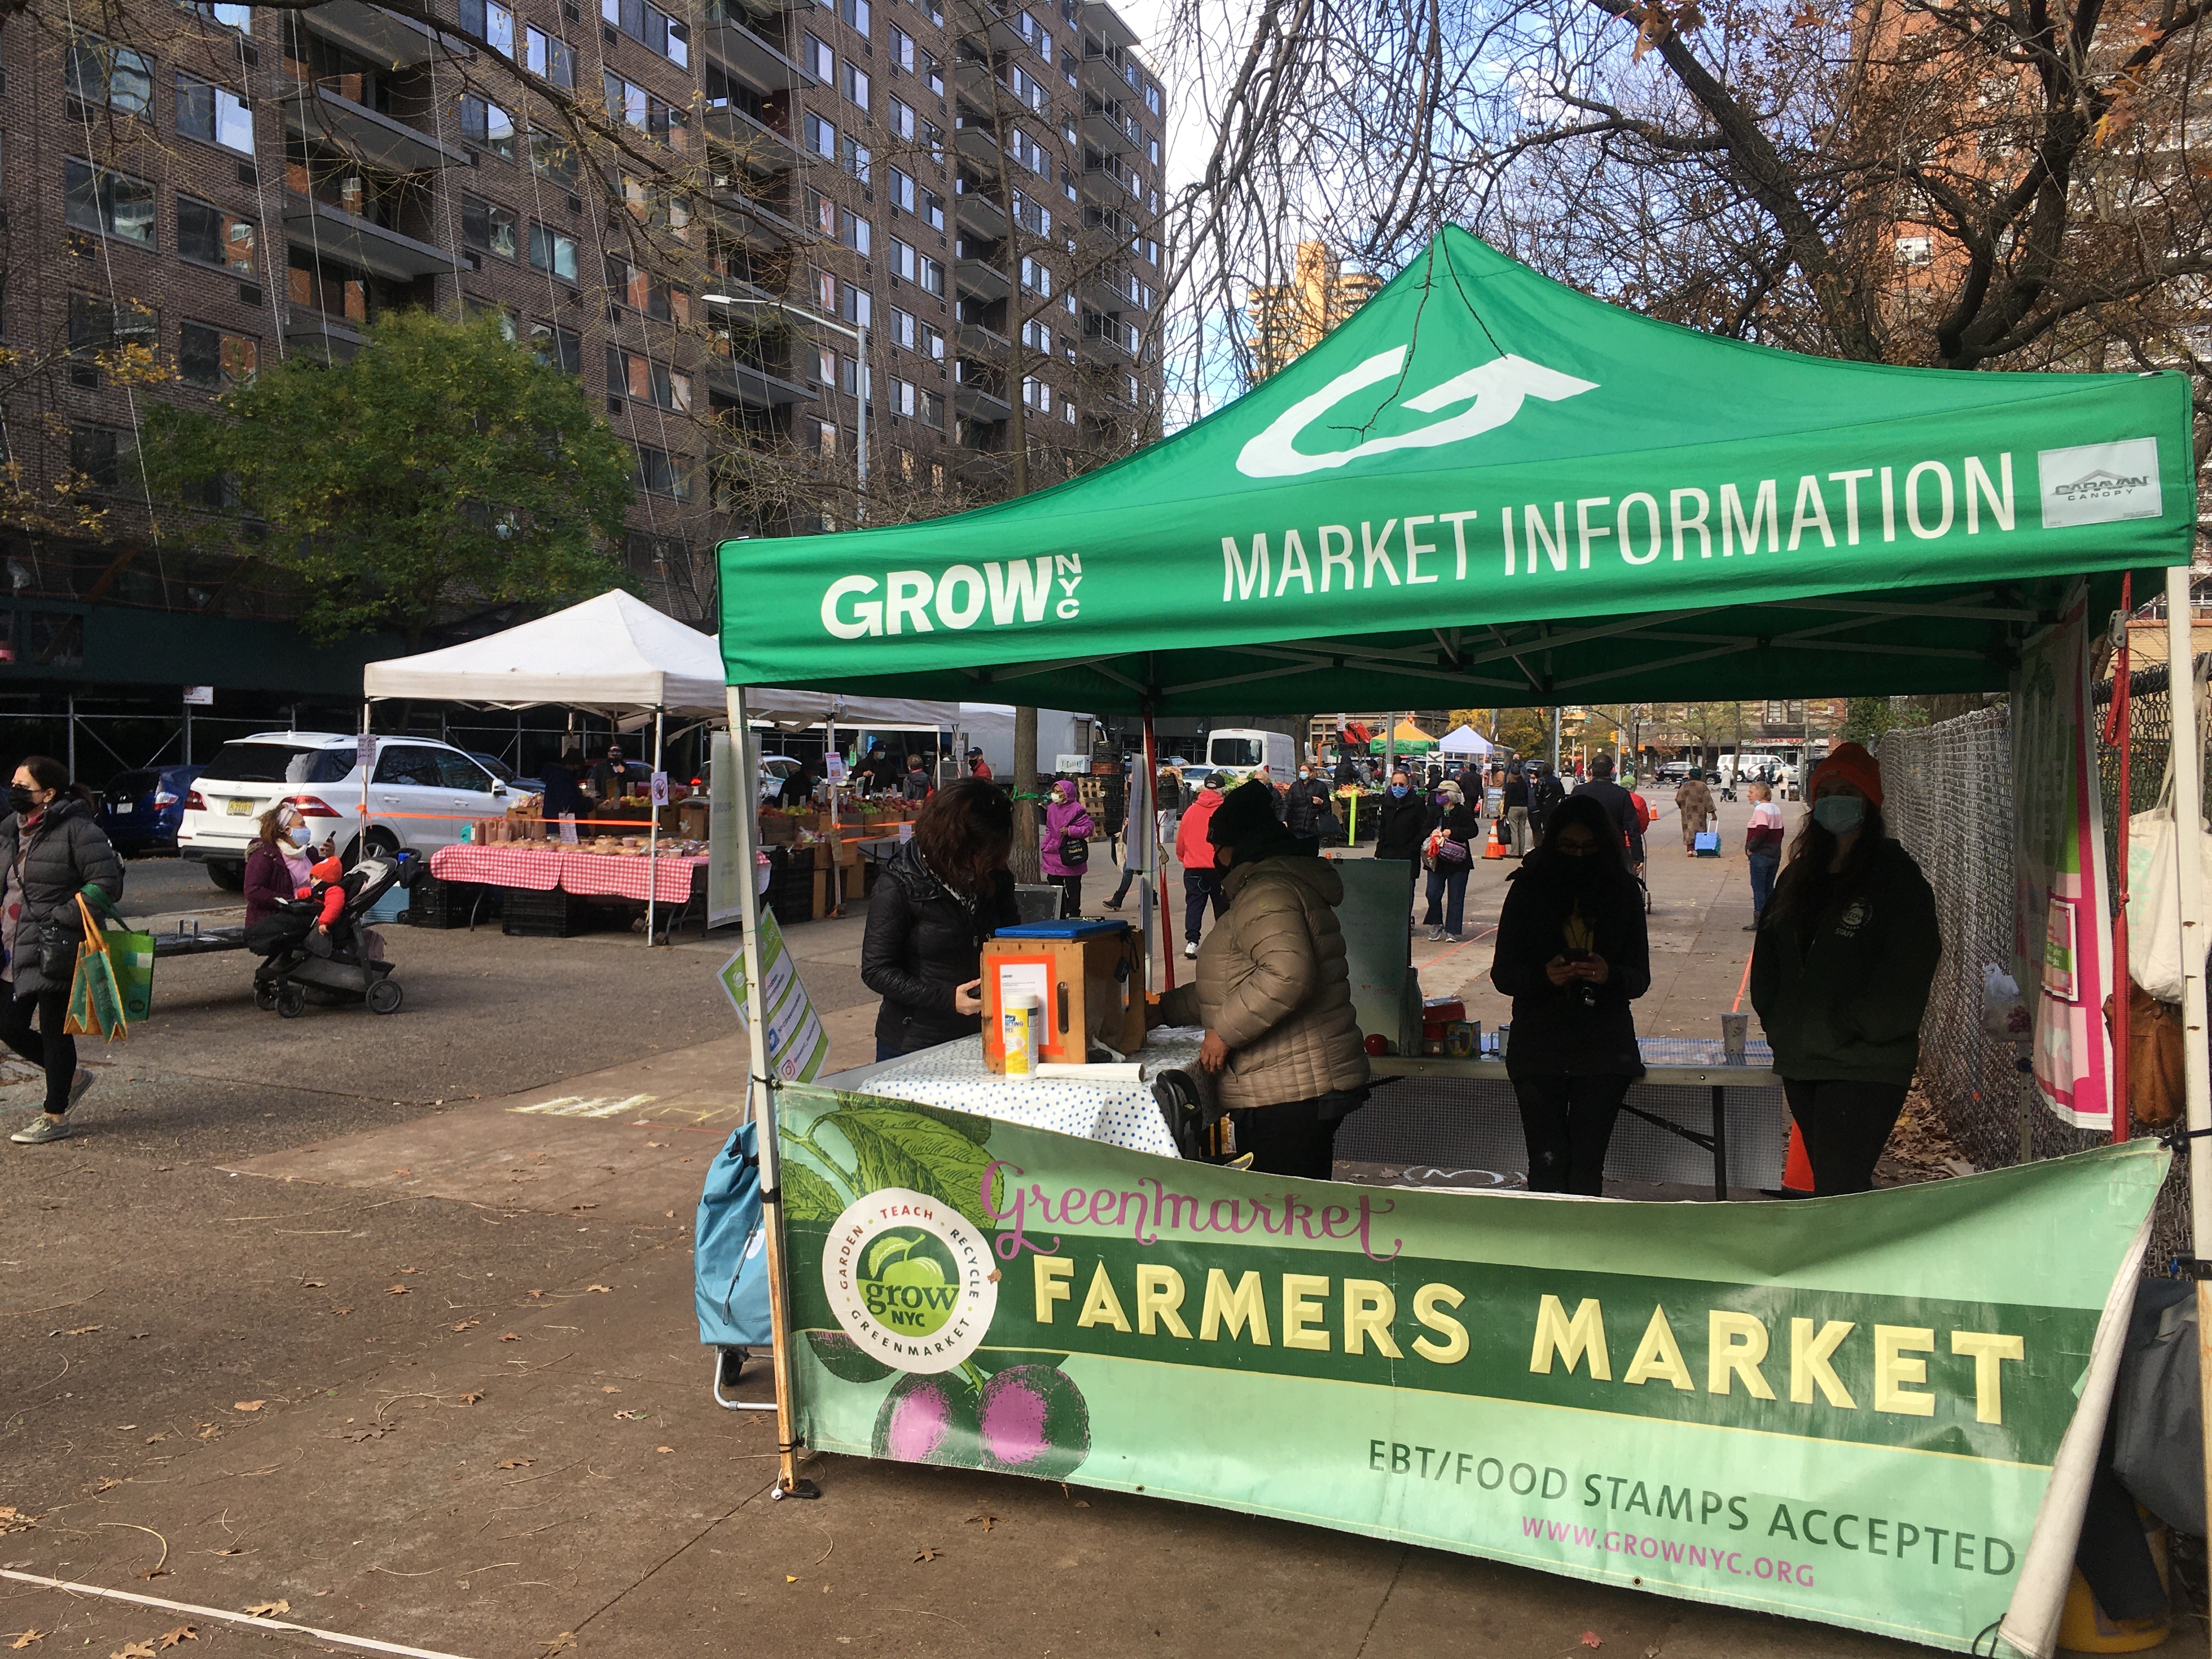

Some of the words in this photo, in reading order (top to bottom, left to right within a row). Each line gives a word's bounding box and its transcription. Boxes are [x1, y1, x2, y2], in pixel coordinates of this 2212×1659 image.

[2055, 476, 2149, 495] CARAVAN
[2068, 489, 2133, 501] CANOPY
[1221, 510, 1479, 602] MARKET
[1502, 451, 2016, 575] INFORMATION
[821, 556, 1053, 640] GROW
[1057, 553, 1082, 619] NYC
[1835, 928, 1855, 938] STAFF
[879, 1204, 933, 1221] TEACH
[979, 1159, 1403, 1262] Greenmarket
[839, 1224, 864, 1290] GARDEN
[950, 1228, 980, 1299] RECYCLE
[851, 1309, 970, 1356] GREENMARKET
[865, 1283, 960, 1316] grow
[891, 1310, 926, 1327] NYC
[1032, 1253, 1471, 1365] FARMERS
[1528, 1294, 2025, 1426] MARKET
[1368, 1438, 1568, 1500] EBT/FOOD
[1583, 1472, 1750, 1531] STAMPS
[1769, 1503, 2017, 1576] ACCEPTED
[1521, 1515, 1815, 1588] WWW.GROWNYC.ORG
